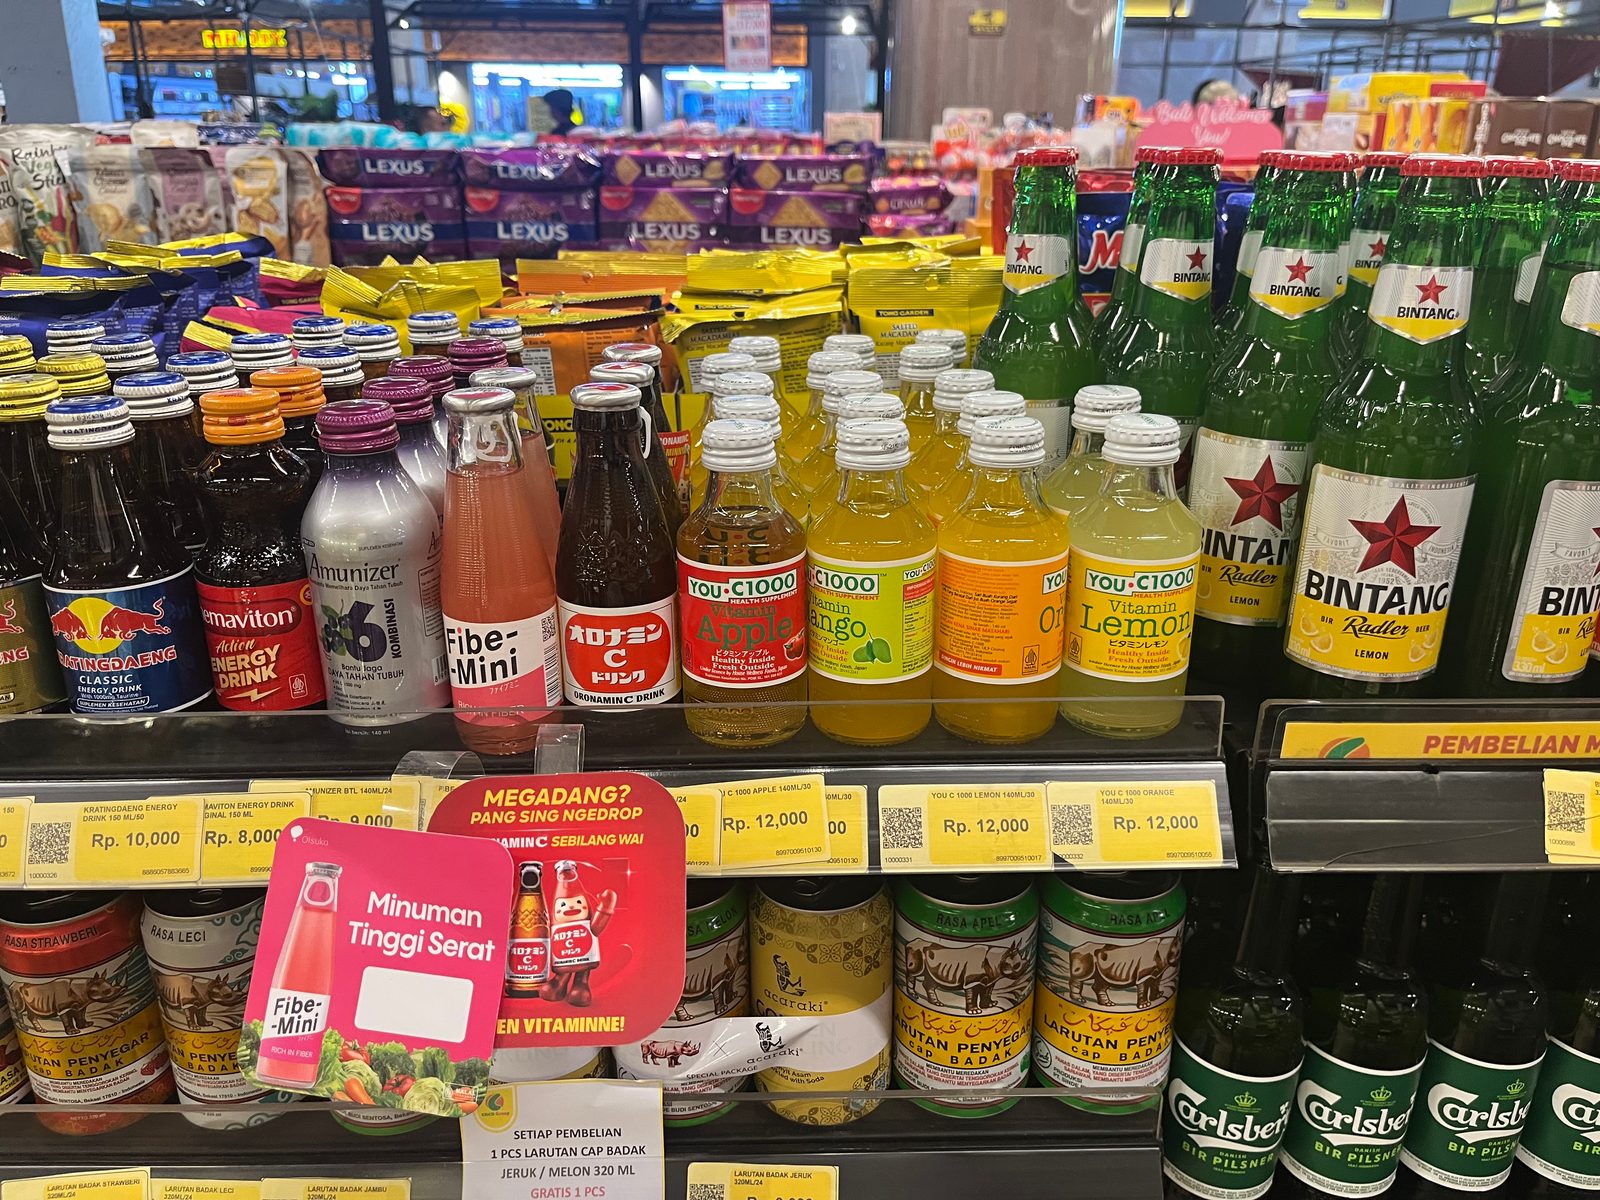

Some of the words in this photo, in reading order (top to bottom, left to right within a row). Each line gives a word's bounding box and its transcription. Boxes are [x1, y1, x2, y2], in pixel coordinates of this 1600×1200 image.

[365, 158, 425, 177] LEXUS
[645, 163, 702, 180] LEXUS
[784, 166, 842, 183] LEXUS
[362, 222, 436, 243] LEXUS
[497, 221, 570, 243] LEXUS
[633, 222, 701, 243] LEXUS
[760, 226, 833, 246] LEXUS
[1006, 264, 1042, 275] BINTANG
[1173, 271, 1211, 283] BINTANG
[1269, 284, 1321, 298] BINTANG
[1396, 305, 1456, 320] BINTANG
[1200, 528, 1290, 566] INTAN
[1322, 534, 1350, 547] FAVORIT
[1564, 548, 1592, 558] FAVORIT
[309, 553, 399, 584] Amunizer
[1219, 564, 1279, 588] Radler
[761, 590, 798, 603] SUPPLEMENT
[1229, 595, 1260, 606] LEMON
[1304, 568, 1450, 616] BINTANG
[710, 603, 777, 618] Vitamin
[809, 592, 851, 615] itamin
[1108, 599, 1177, 615] Vitamin
[1538, 586, 1600, 617] BINT
[202, 607, 294, 630] emaviton
[809, 609, 867, 641] ango
[1080, 603, 1191, 638] Lemon
[1320, 615, 1334, 625] BIR
[1342, 614, 1410, 639] Radler
[1415, 624, 1431, 634] BEER
[347, 600, 387, 662] 6
[383, 598, 402, 659] KOMBINASI
[569, 623, 663, 645] オロナミン
[696, 614, 793, 650] Apple
[1557, 626, 1571, 635] BIR
[215, 639, 256, 654] Action
[446, 626, 518, 655] Fibe-
[211, 643, 281, 674] ENERGY
[603, 649, 628, 668] C
[711, 655, 747, 664] Healthy
[748, 655, 776, 664] Inside
[1354, 648, 1390, 660] LEMON
[450, 648, 518, 685] -Mini
[712, 663, 737, 671] Fresh
[739, 662, 775, 671] Outside
[973, 663, 998, 673] NIKMAT
[79, 674, 133, 685] CLASSIC
[219, 663, 278, 689] DRINK
[591, 669, 646, 686] ドリンク
[77, 685, 109, 694] ENERGY
[111, 683, 142, 694] DRINK
[1423, 734, 1579, 755] PEMBELIAN
[482, 784, 632, 808] MEGADANG?
[729, 789, 735, 797] C
[752, 785, 777, 794] APPLE
[778, 782, 812, 792] 140ML/30
[956, 791, 973, 799] 1000
[974, 791, 1001, 799] LEMON
[1002, 791, 1035, 799] 140ML/30
[1100, 789, 1117, 797] YOU
[1142, 789, 1175, 797] ORANGE
[83, 804, 144, 814] KRATINGDAENG
[145, 803, 179, 812] ENERGY
[236, 801, 269, 810] ENERGY
[270, 800, 295, 809] DRINK
[1101, 797, 1134, 805] 140ML/30
[82, 814, 107, 822] DRINK
[108, 813, 122, 822] 150
[122, 813, 145, 821] ML/50
[470, 811, 517, 825] PANG
[518, 810, 560, 823] SING
[562, 806, 643, 822] NGEDROP
[722, 817, 750, 834] Rp.
[755, 810, 808, 828] 12,000
[1113, 816, 1141, 833] Rp.
[1146, 815, 1199, 832] 12,000
[943, 818, 971, 836] Rp.
[976, 818, 1029, 835] 12,000
[91, 833, 119, 851] Rp.
[125, 831, 181, 848] 10,000
[204, 829, 233, 847] Rp.
[238, 828, 281, 846] 8,000
[550, 834, 617, 848] SEBILANG
[618, 833, 645, 846] WAI
[367, 889, 482, 929] Minuman
[935, 912, 968, 930] RASA
[972, 913, 1001, 930] APEL
[1110, 911, 1141, 926] RASA
[4, 934, 28, 949] RASA
[31, 924, 98, 948] STRAWBERI
[150, 923, 175, 943] RASA
[178, 930, 207, 943] LECI
[348, 920, 426, 960] Tinggi
[428, 931, 496, 962] Serat
[273, 996, 322, 1016] Fibe-
[764, 987, 823, 1013] acaraki
[271, 1012, 319, 1035] -Mini
[523, 1016, 625, 1034] VITAMINNE!
[1044, 1013, 1118, 1050] LARUTAN
[957, 1018, 1031, 1054] PENYEGAR
[68, 1031, 150, 1068] PENYEGAR
[746, 1046, 800, 1065] acaraki
[908, 1040, 933, 1058] cap
[950, 1048, 1012, 1066] BADAK
[1071, 1046, 1101, 1061] cap
[65, 1058, 124, 1077] BADAK
[187, 1061, 239, 1073] BADAK
[686, 1071, 720, 1081] SPECIAL
[720, 1065, 758, 1077] PACKAGE
[513, 1128, 554, 1141] SETIAP
[555, 1126, 622, 1139] PEMBELIAN
[490, 1149, 497, 1160] 1
[500, 1148, 522, 1160] PCS
[524, 1147, 579, 1159] LARUTAN
[580, 1146, 604, 1158] CAP
[605, 1144, 647, 1157] BADAK
[1181, 1141, 1207, 1162] BIR
[1212, 1152, 1274, 1169] PILSNER
[1313, 1141, 1342, 1159] BIR
[1448, 1141, 1476, 1156] BIR
[500, 1167, 538, 1180] JERUK
[539, 1166, 546, 1180] /
[547, 1165, 591, 1179] MELON
[593, 1165, 615, 1178] 320
[616, 1163, 636, 1176] ML
[733, 1171, 762, 1179] LARUTAN
[763, 1171, 788, 1179] BADAK
[789, 1172, 813, 1180] JERUK
[46, 1183, 78, 1192] LARUTAN
[78, 1181, 101, 1190] BADAK
[102, 1178, 141, 1188] STRAWBERI
[164, 1185, 194, 1193] LARUTAN
[195, 1186, 219, 1194] BADAK
[307, 1185, 338, 1193] LARUTAN
[339, 1185, 363, 1193] BADAK
[530, 1187, 571, 1200] GRATIS
[575, 1187, 580, 1198] 1
[581, 1185, 606, 1198] PCS
